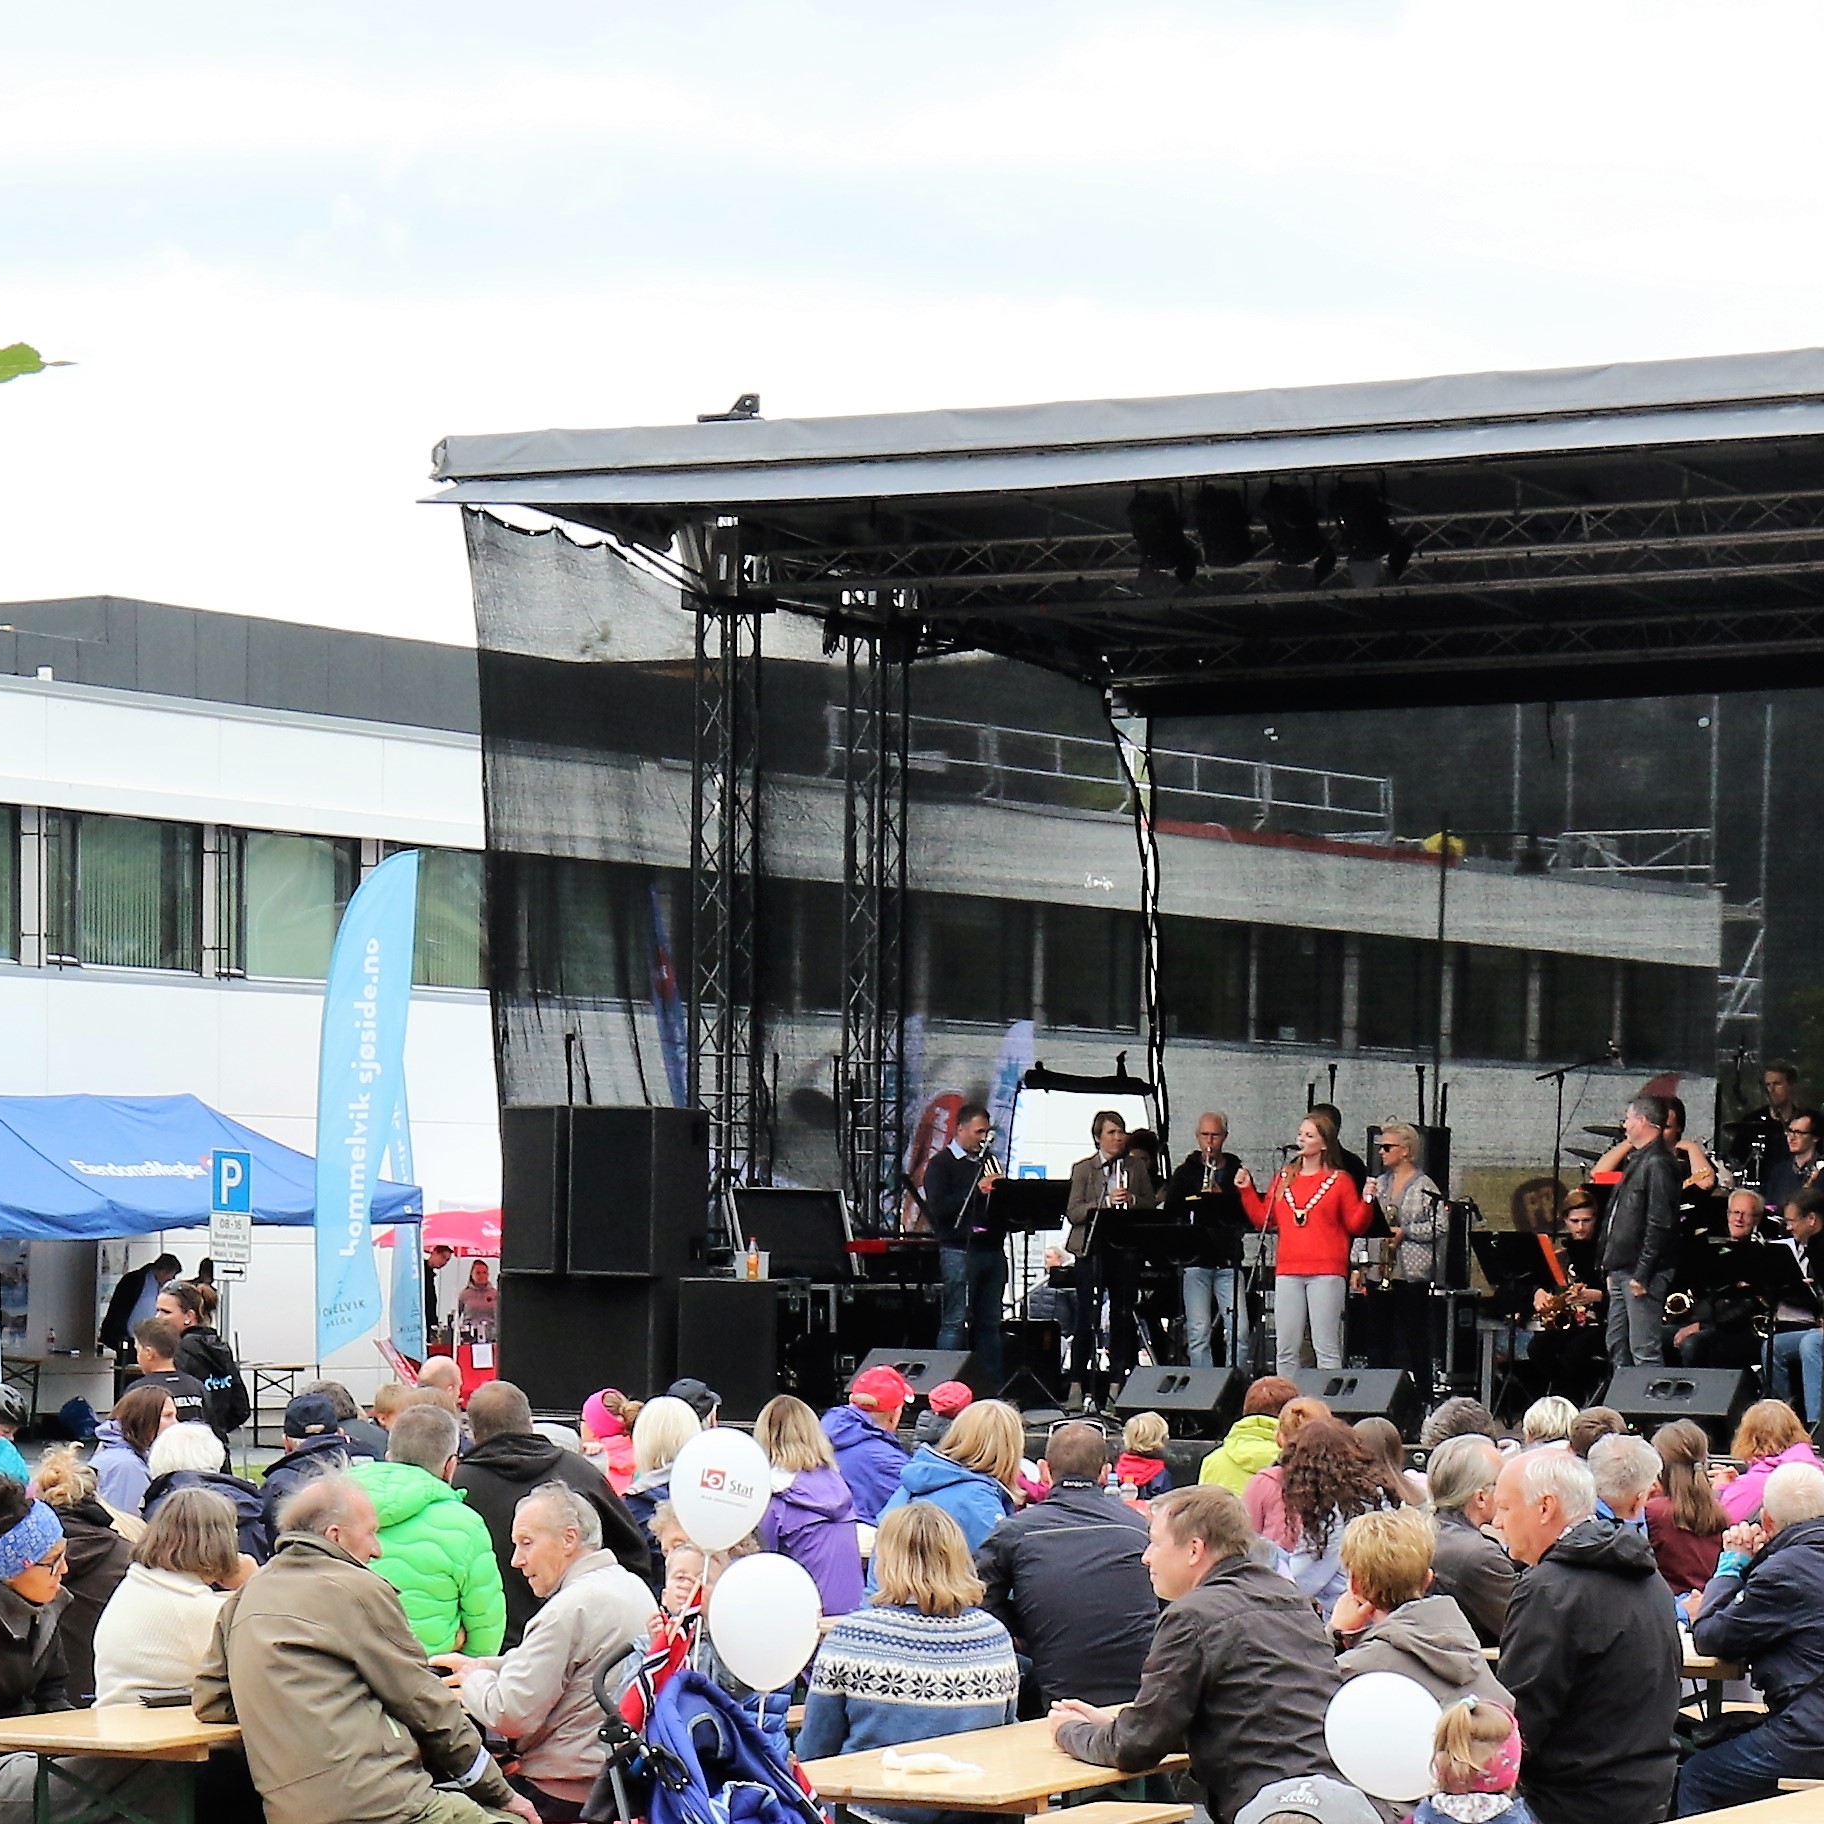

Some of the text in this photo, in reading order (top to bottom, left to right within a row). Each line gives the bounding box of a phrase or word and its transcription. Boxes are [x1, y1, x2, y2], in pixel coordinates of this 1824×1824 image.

[338, 937, 382, 1258] hommelvik sjøside.no
[220, 1157, 243, 1205] P
[730, 1480, 754, 1496] Stat
